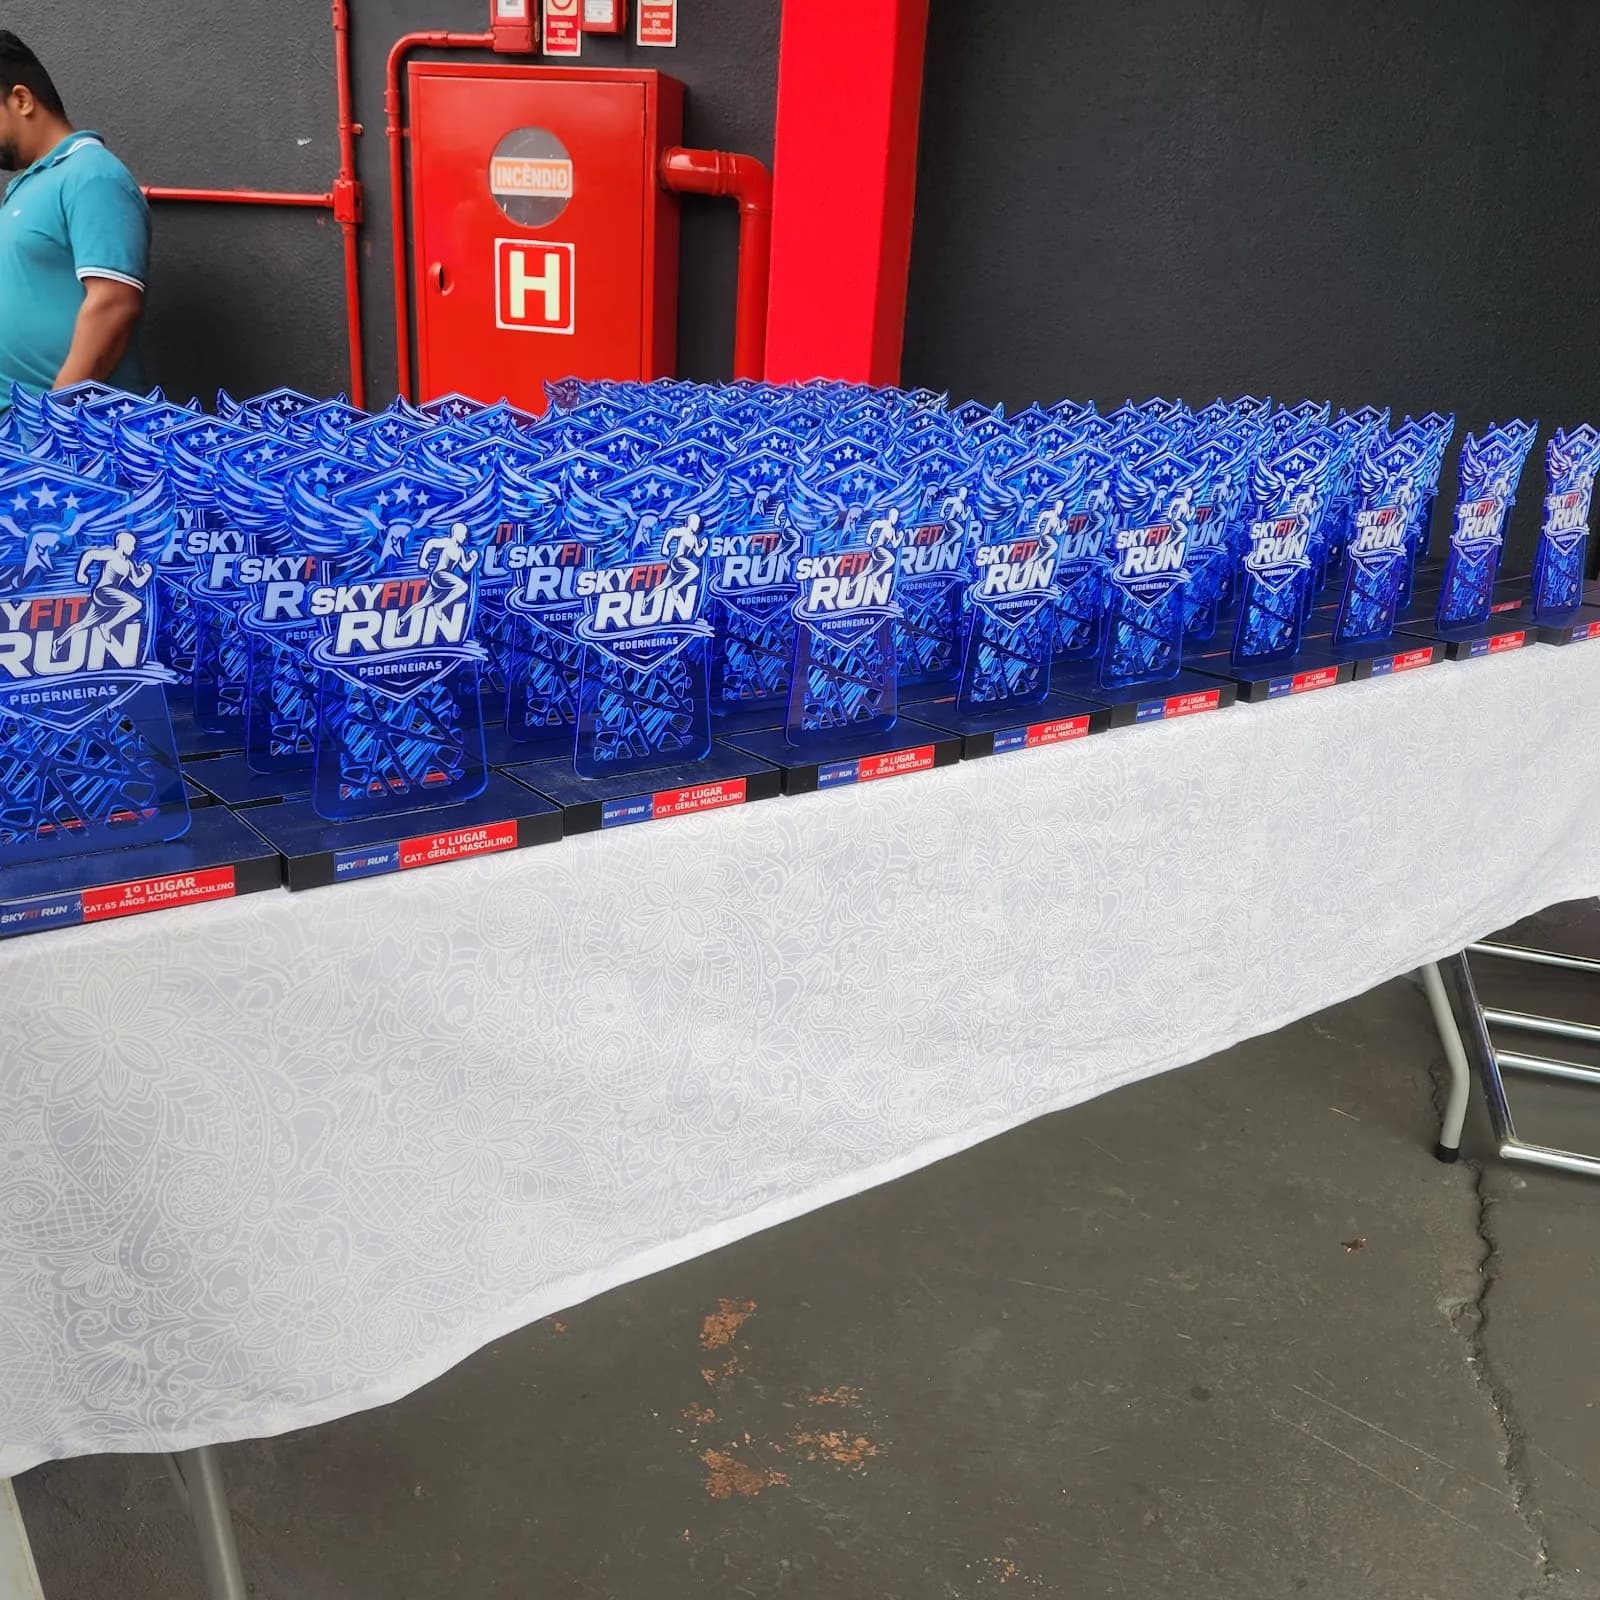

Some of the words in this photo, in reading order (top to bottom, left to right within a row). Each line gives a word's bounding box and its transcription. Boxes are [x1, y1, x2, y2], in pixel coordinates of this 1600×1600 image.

[495, 163, 568, 189] INCÊNDIO
[510, 250, 560, 321] H
[1251, 519, 1297, 538] SKYFIT
[1460, 513, 1500, 540] RUN
[1551, 505, 1588, 530] RUN
[187, 530, 245, 554] SKY
[710, 534, 779, 557] SKYFIT
[902, 526, 943, 545] YFIT
[1062, 532, 1102, 559] UN
[1117, 525, 1172, 549] SKYFIT
[1190, 521, 1224, 547] UN
[1359, 524, 1404, 550] RUN
[508, 543, 582, 569] SKYFI
[900, 542, 961, 574] RUN
[975, 540, 1040, 567] SKYFIT
[1122, 542, 1185, 575] RUN
[1255, 535, 1308, 564] RUN
[796, 553, 871, 580] SKYFIT
[984, 559, 1056, 595] RUN
[577, 563, 669, 596] SKYFIT
[310, 579, 429, 616] SKYFIT
[736, 594, 788, 605] PEDERNEIRAS
[808, 573, 892, 612] RUN
[0, 596, 88, 631] YFIT
[594, 585, 698, 631] RUN
[335, 603, 467, 655] RUN
[821, 616, 875, 630] PEDERNEIRAS
[612, 635, 679, 651] PEDERNEIRAS
[359, 660, 443, 678] PEDERNEIRAS
[9, 684, 119, 706] PEDERNEIRAS
[1053, 721, 1074, 732] LUGAR
[876, 765, 896, 774] GERAL
[896, 758, 931, 770] MASCULINO
[879, 758, 889, 767] 3º
[890, 752, 915, 765] LUGAR
[674, 801, 699, 811] GERAL
[700, 791, 743, 806] MASCULINO
[678, 791, 690, 801] 2º
[692, 786, 723, 800] LUGAR
[628, 805, 645, 815] RUN
[403, 853, 425, 864] CAT.
[427, 847, 458, 859] GERAL
[459, 835, 513, 852] MASCULINO
[431, 837, 445, 848] 1º
[448, 830, 487, 847] LUGAR
[336, 859, 366, 872] SKYFIT
[367, 855, 388, 866] RUN
[83, 900, 117, 914] CAT.65
[119, 896, 145, 909] ANOS
[147, 891, 179, 904] ACIMA
[181, 882, 234, 897] MASCULINO
[124, 885, 141, 898] 1º
[145, 877, 196, 894] LUGAR
[1, 909, 40, 924] SKYFIT
[41, 905, 67, 917] RUN
